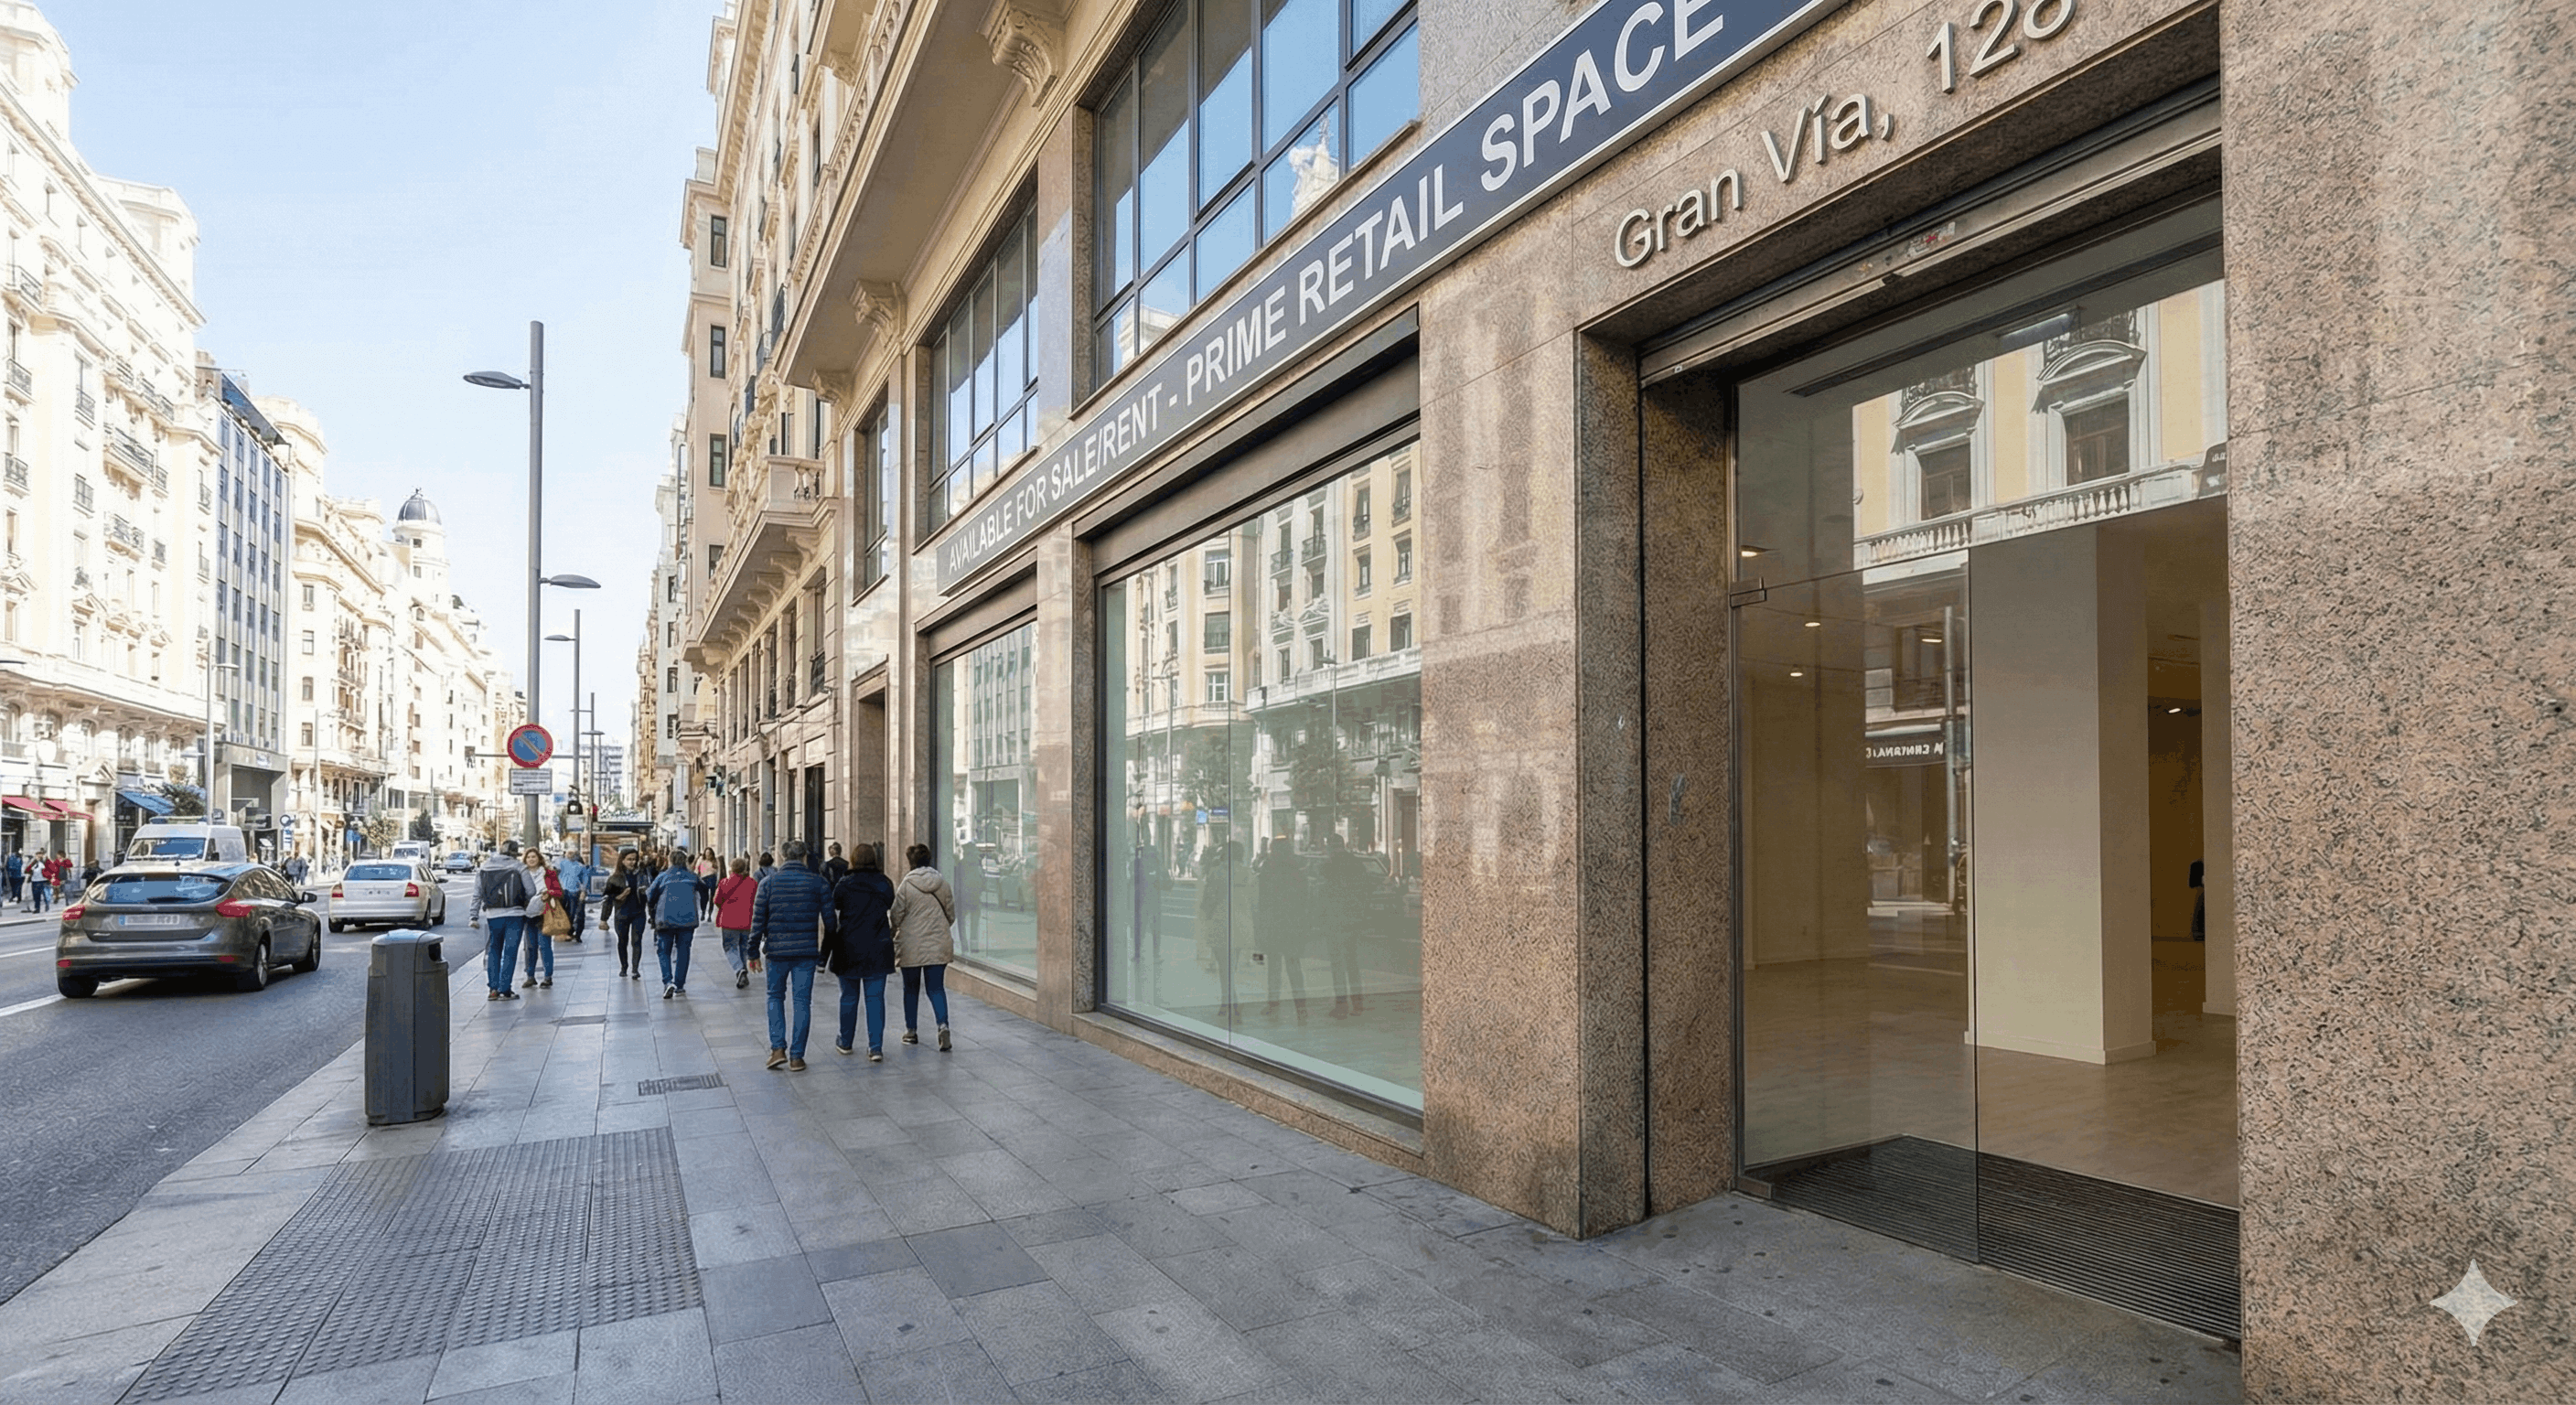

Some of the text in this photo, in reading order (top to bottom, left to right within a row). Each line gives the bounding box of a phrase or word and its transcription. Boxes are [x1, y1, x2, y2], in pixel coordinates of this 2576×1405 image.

[949, 500, 1013, 575] AVAILABLE
[1016, 475, 1047, 527] FOR
[1051, 382, 1163, 501] SALE/RENT
[1186, 284, 1287, 406] PRIME
[1299, 163, 1464, 327] RETAIL
[1480, 0, 1723, 192] SPACE
[1615, 167, 1742, 267] Gran
[1760, 92, 1894, 183] Vía,
